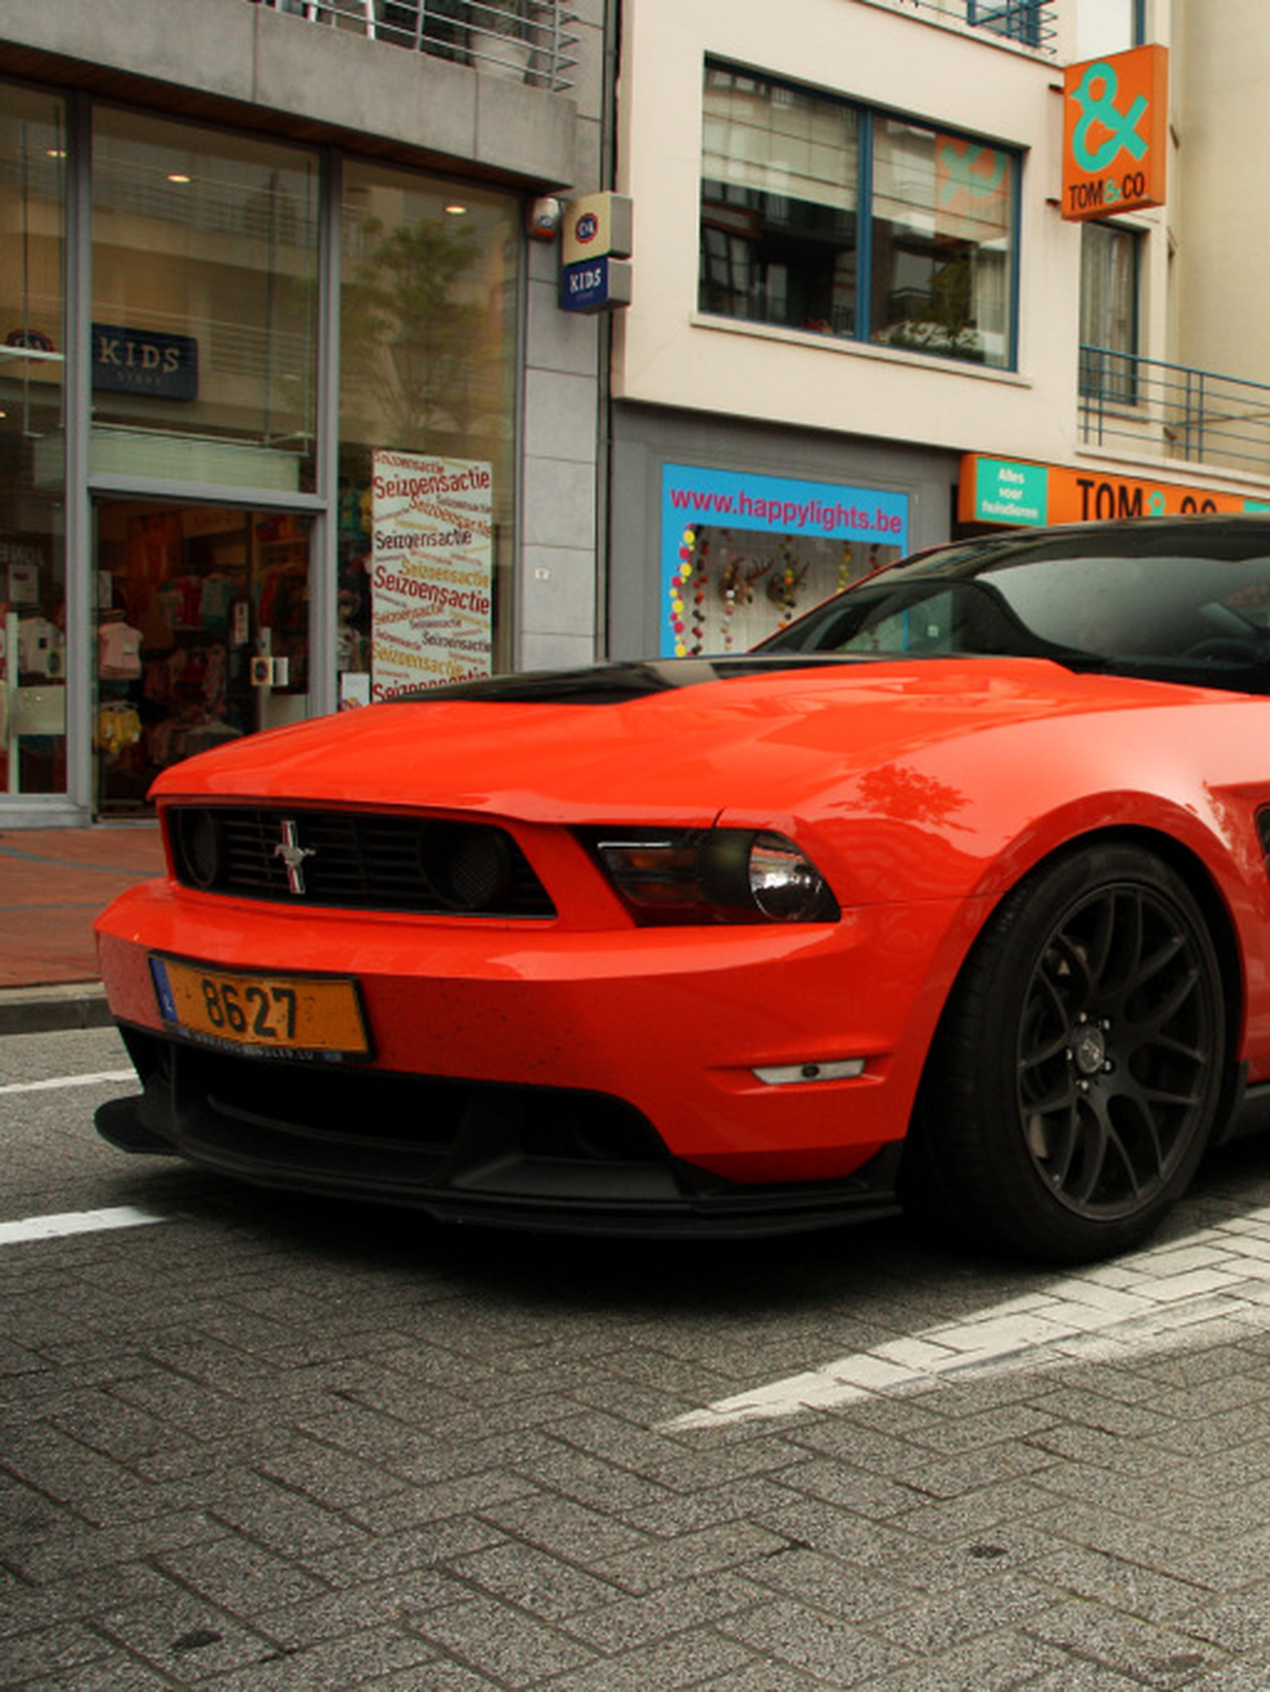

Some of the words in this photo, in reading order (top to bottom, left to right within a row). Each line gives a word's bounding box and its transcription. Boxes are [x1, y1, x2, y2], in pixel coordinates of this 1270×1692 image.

[569, 267, 602, 294] KIDS
[99, 337, 180, 373] KIDS
[373, 465, 492, 499] Seizoensactie
[997, 468, 1025, 485] Alles
[999, 487, 1023, 500] voor
[670, 489, 903, 534] www.happylights.be
[374, 528, 473, 551] Seizoensactie
[373, 564, 490, 616] Seizoensactie
[202, 978, 297, 1039] 8627
